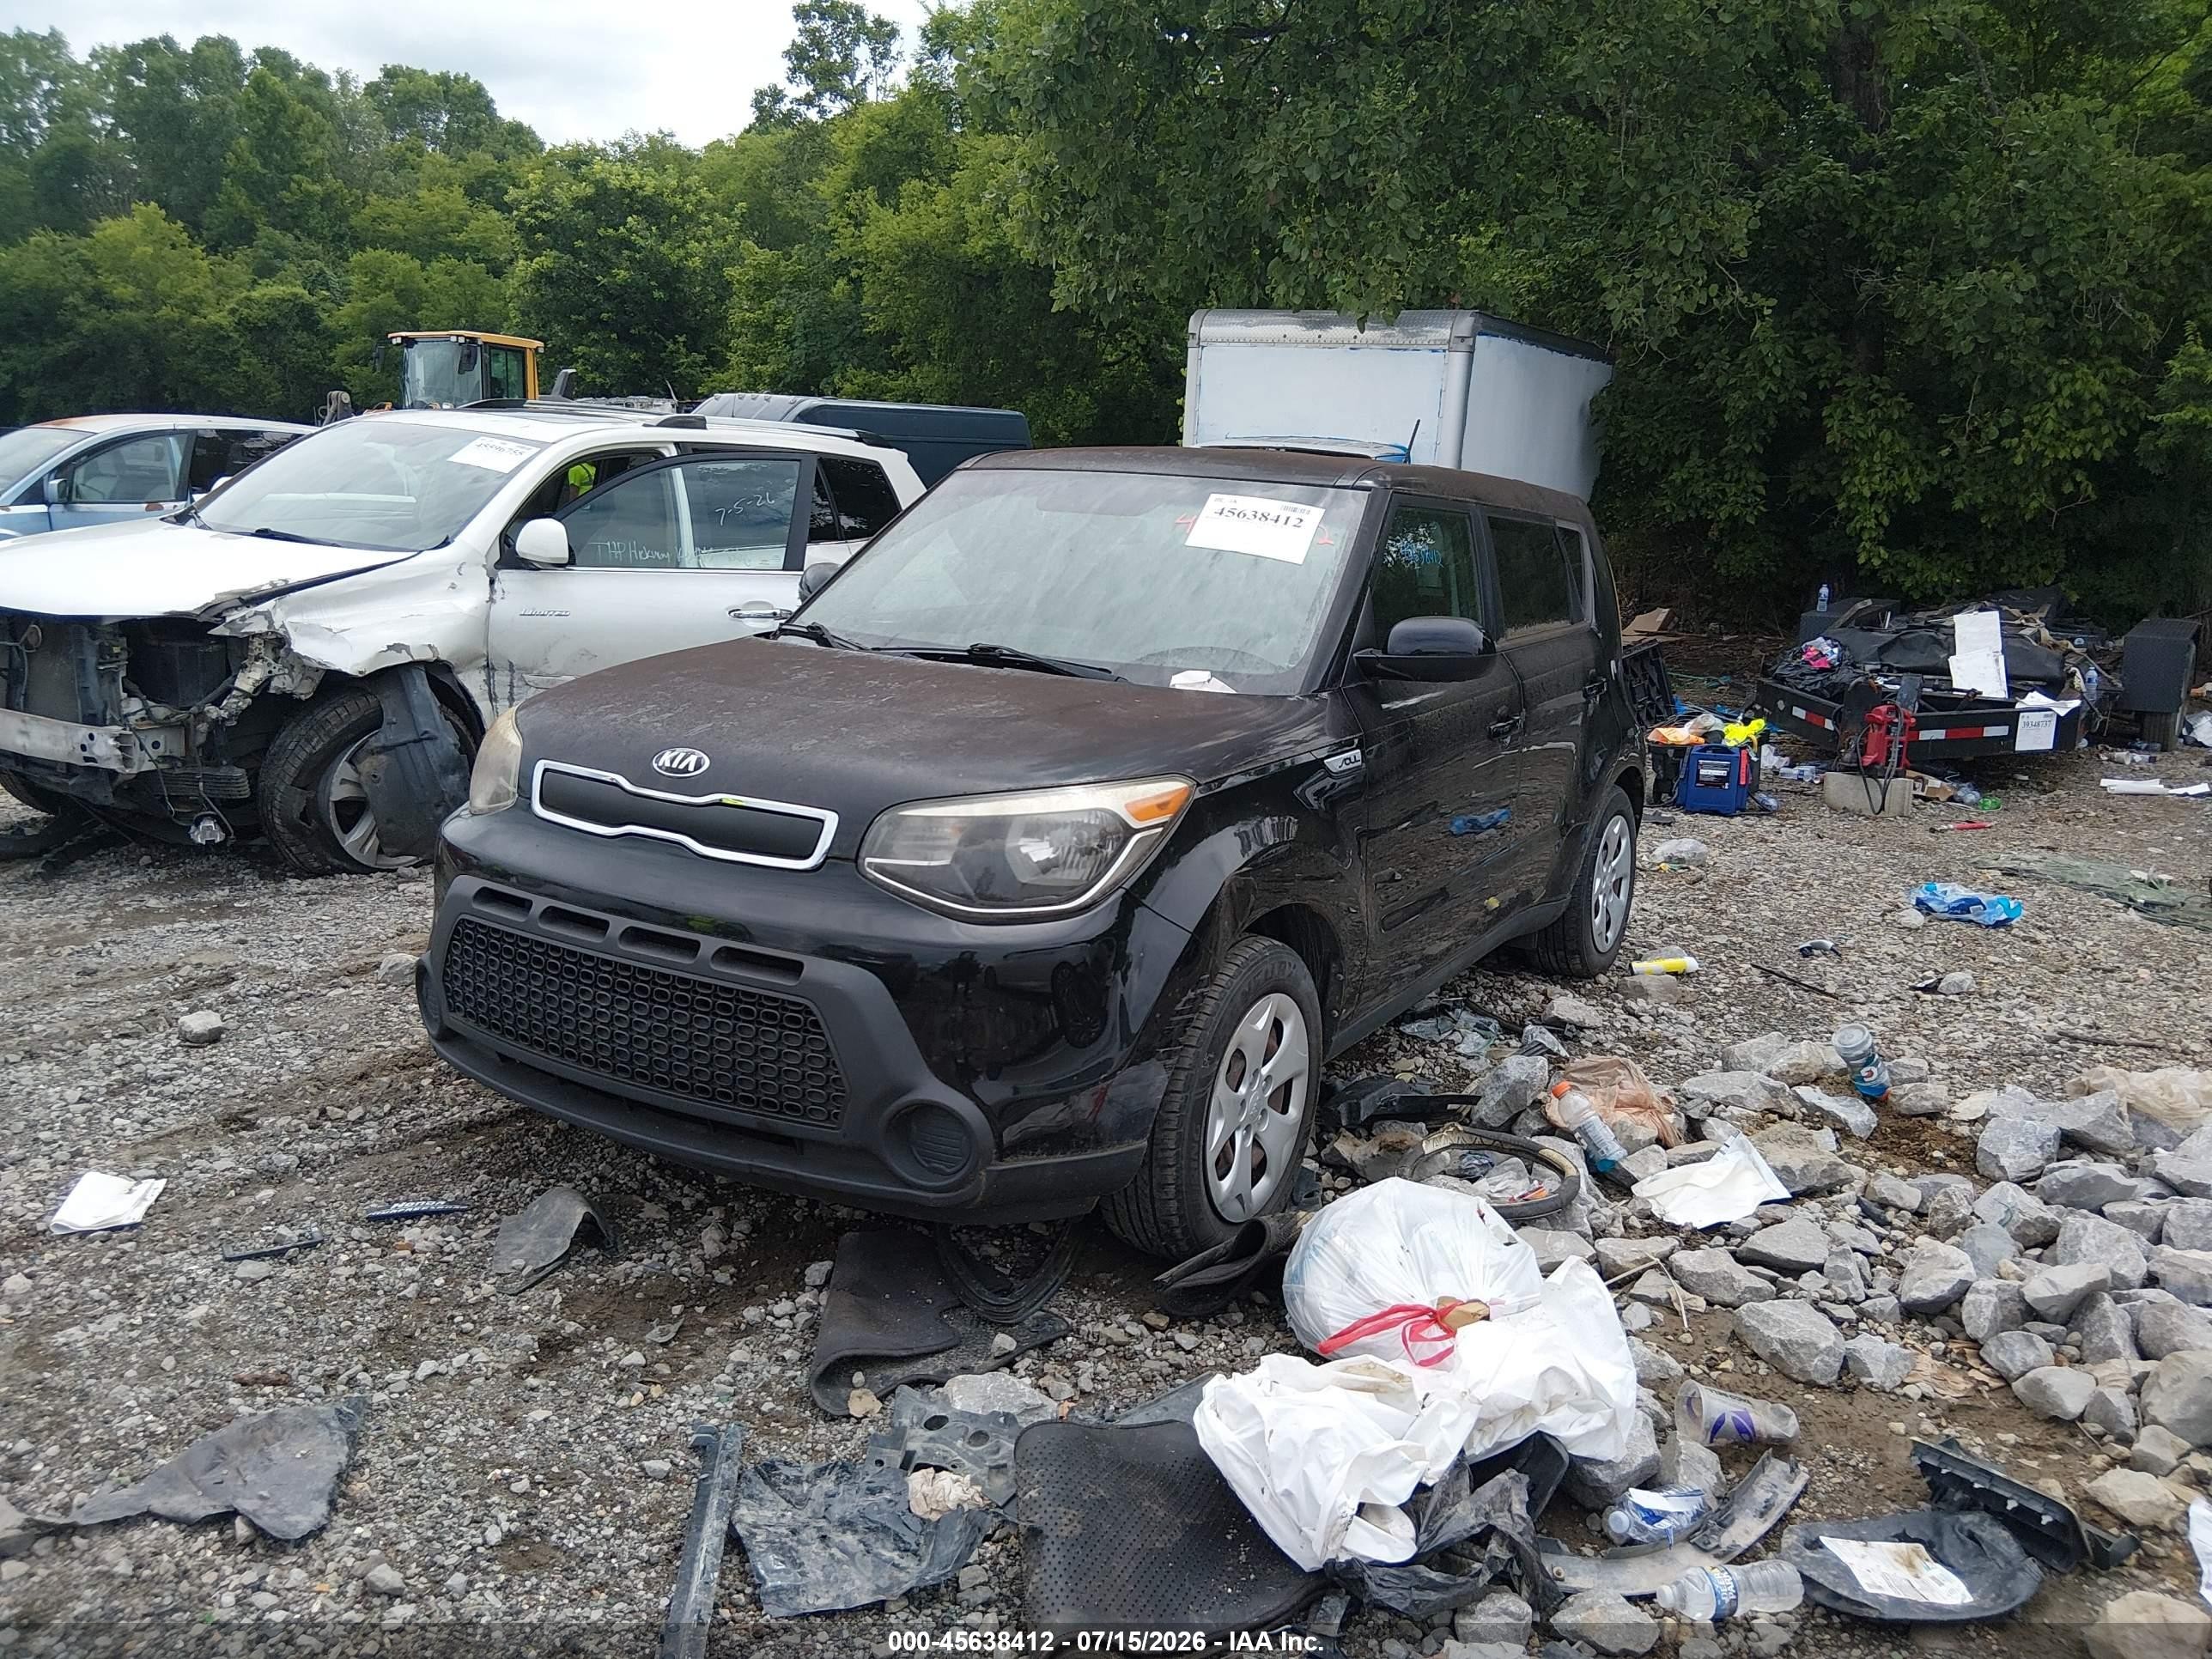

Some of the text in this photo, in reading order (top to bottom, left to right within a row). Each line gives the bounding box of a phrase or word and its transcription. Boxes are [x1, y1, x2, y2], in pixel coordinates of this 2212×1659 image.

[714, 490, 775, 526] 7-5-26
[1213, 507, 1304, 528] 45638412
[2021, 720, 2052, 729] 39348737
[657, 750, 699, 772] KIA
[1338, 755, 1361, 769] SOUL
[390, 1201, 447, 1211] HONDA
